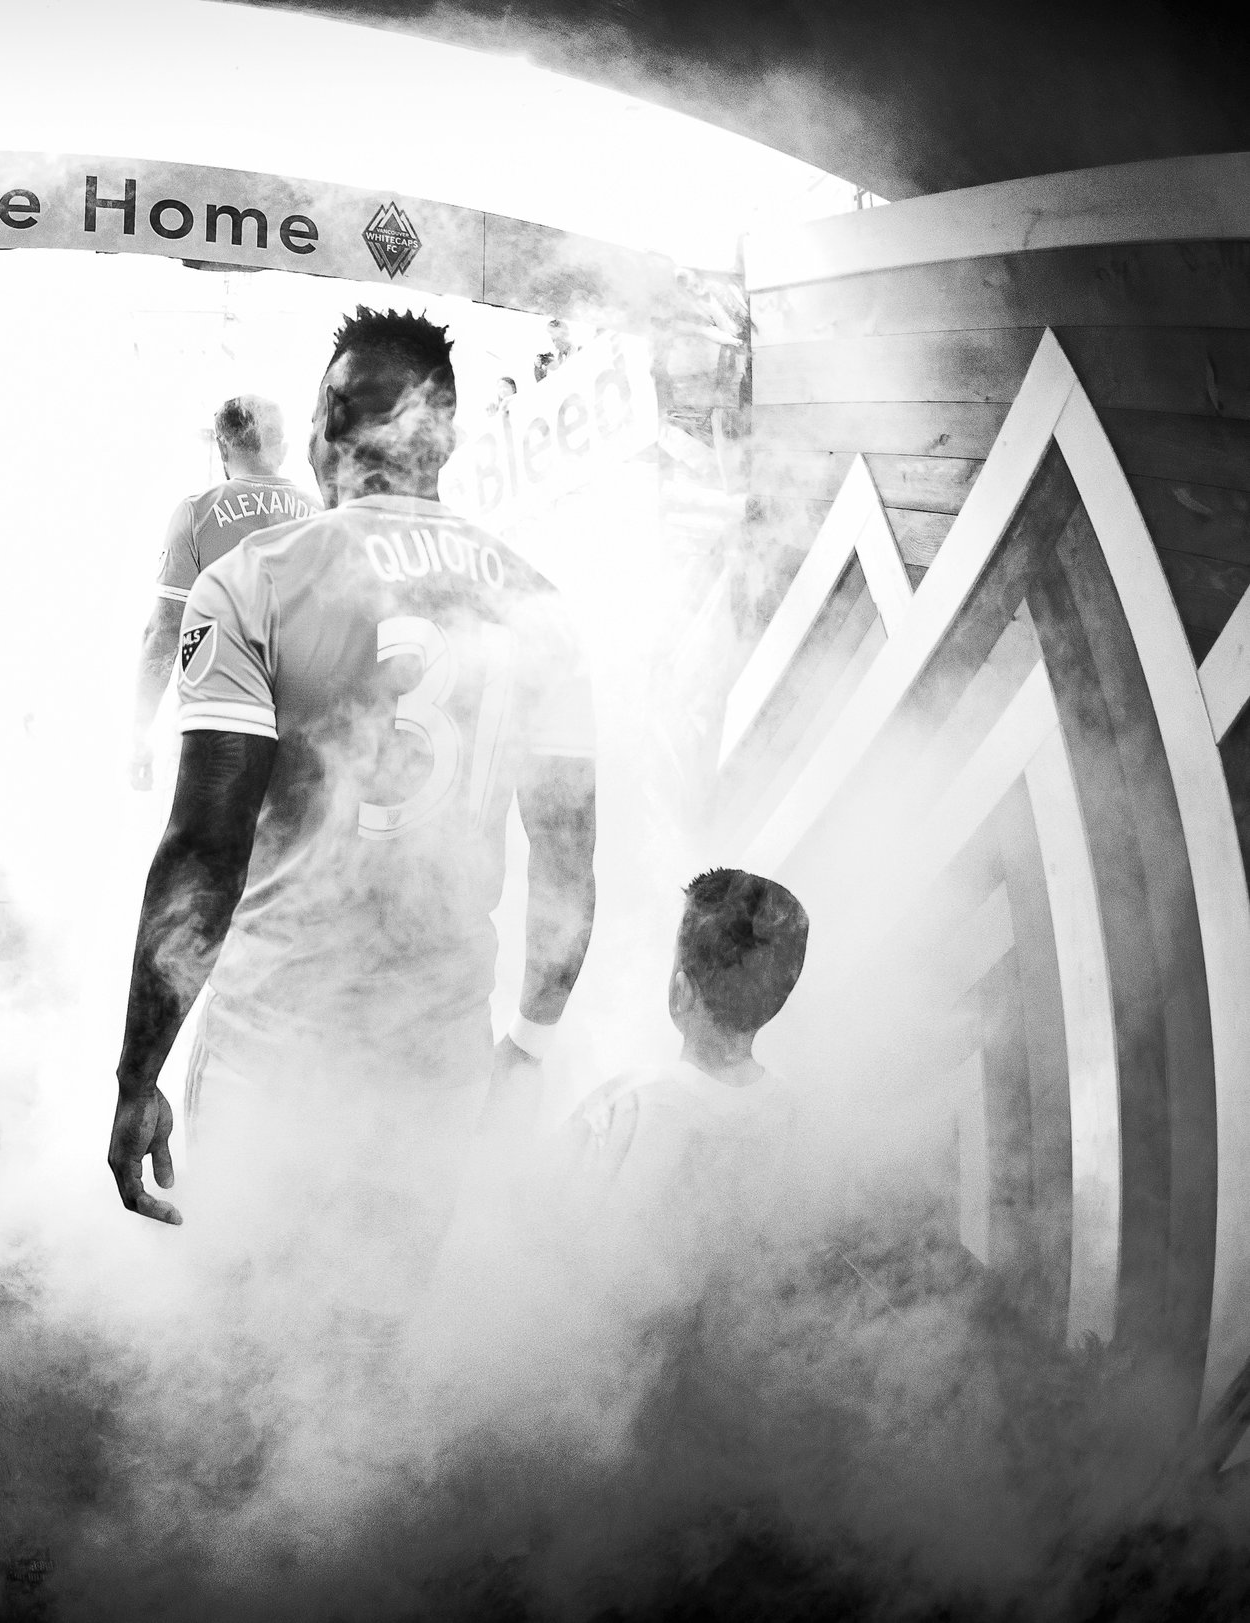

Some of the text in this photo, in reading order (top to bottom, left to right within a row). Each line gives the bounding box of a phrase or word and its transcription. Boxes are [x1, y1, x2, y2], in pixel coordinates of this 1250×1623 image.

[84, 174, 319, 255] Home
[376, 227, 410, 238] VANCOUVER
[365, 231, 419, 249] WHITECAPS
[386, 244, 398, 254] FC
[365, 528, 505, 591] QUIOTO
[357, 615, 518, 841] 31
